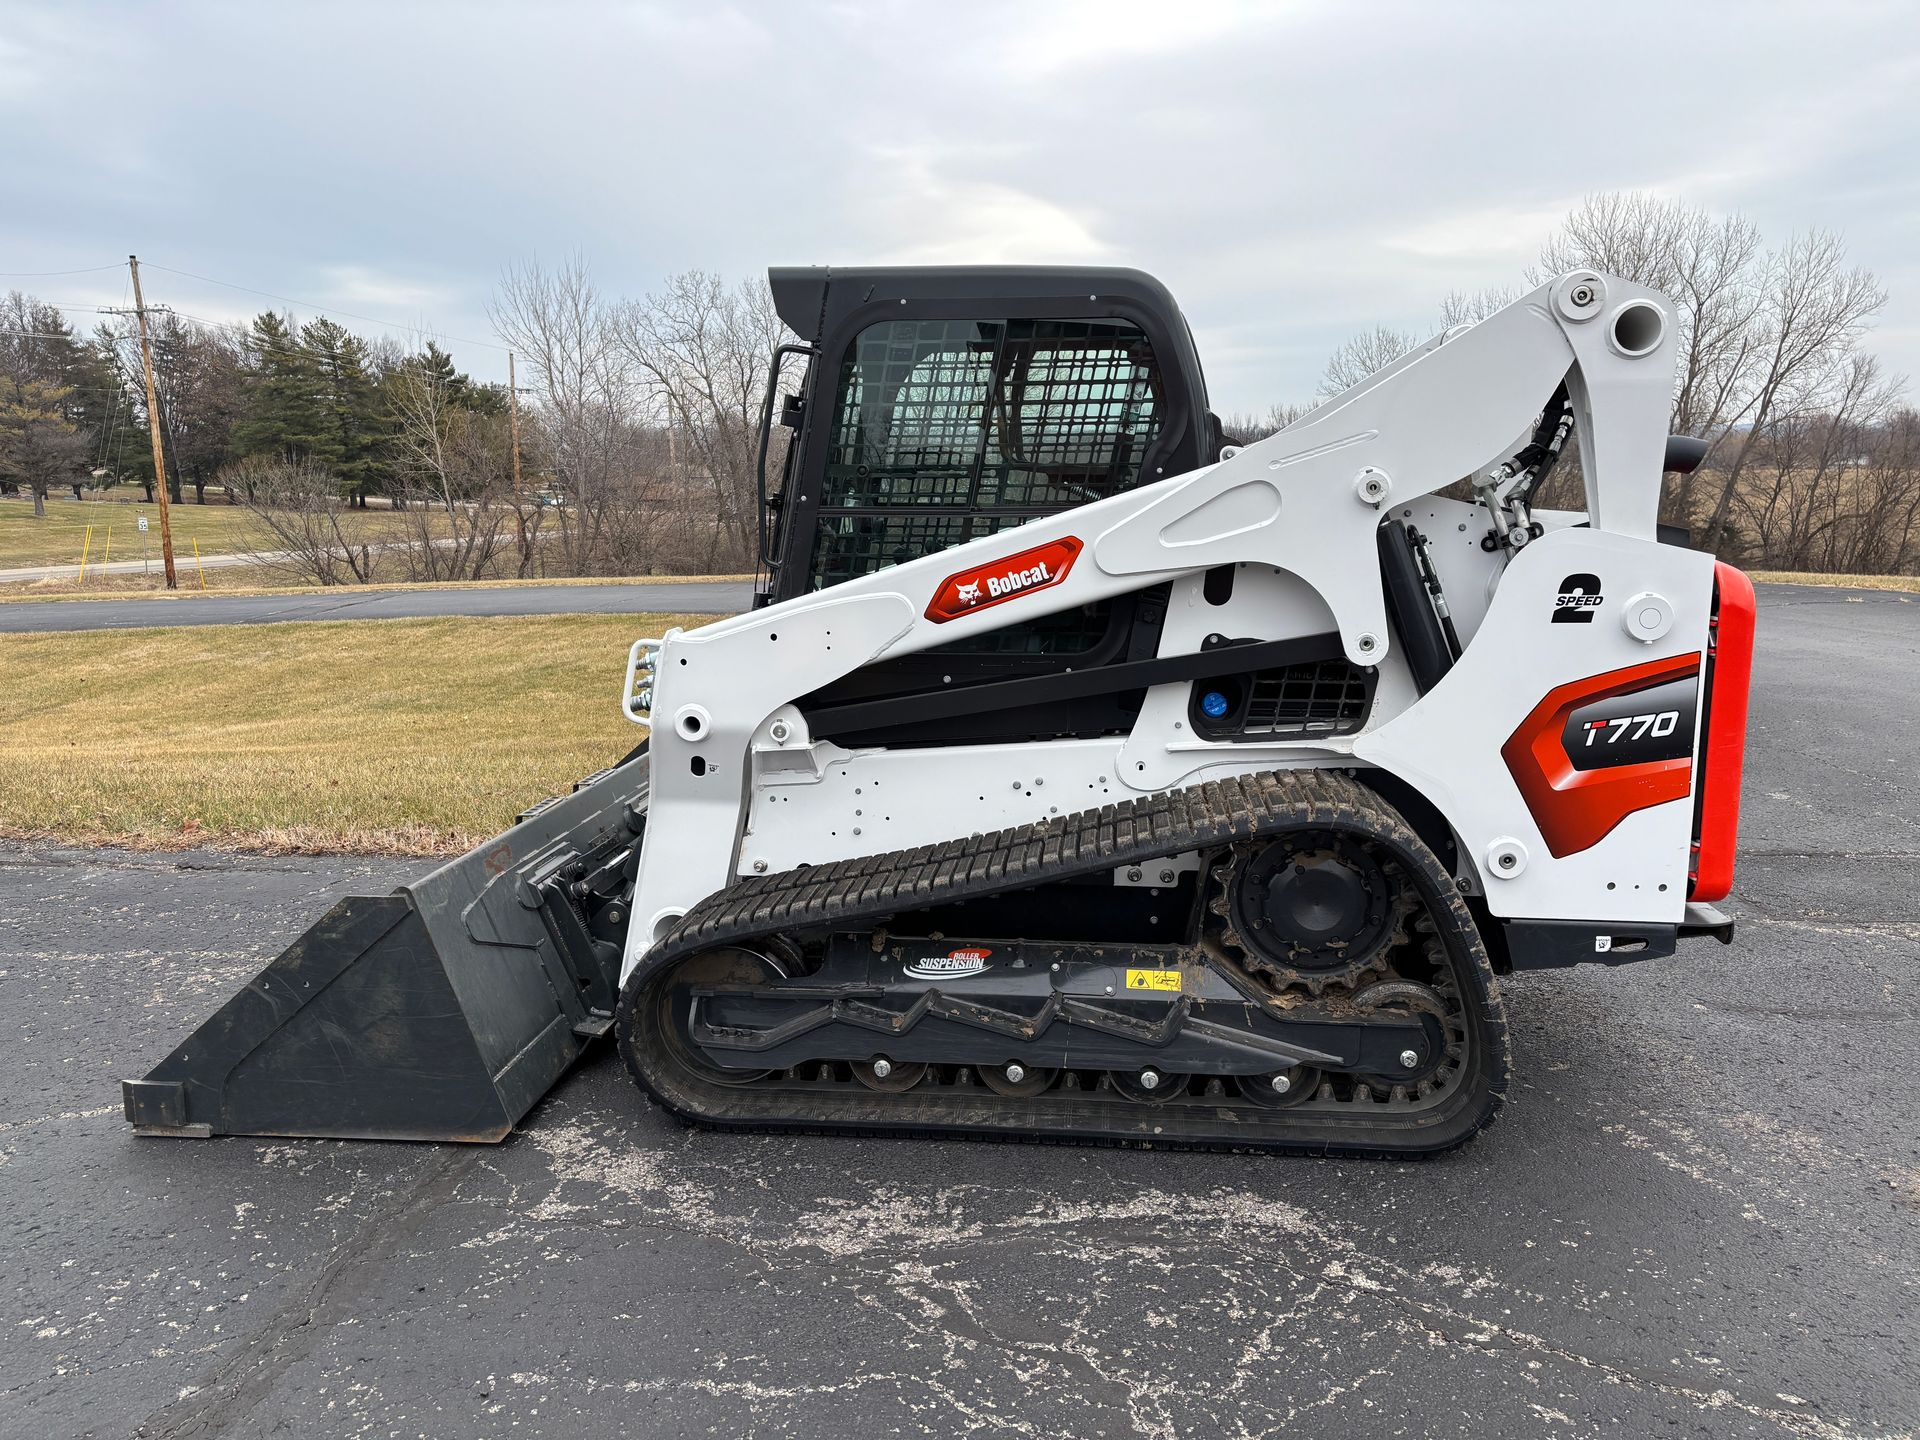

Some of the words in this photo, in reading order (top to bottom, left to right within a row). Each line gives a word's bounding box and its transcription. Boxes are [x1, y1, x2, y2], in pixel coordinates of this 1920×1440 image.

[987, 562, 1050, 597] Bobcat
[1551, 573, 1601, 623] 2
[1555, 595, 1604, 606] SPEED
[1583, 711, 1680, 747] T770
[919, 958, 985, 969] SUSPENSION
[953, 952, 980, 960] ROLLER
